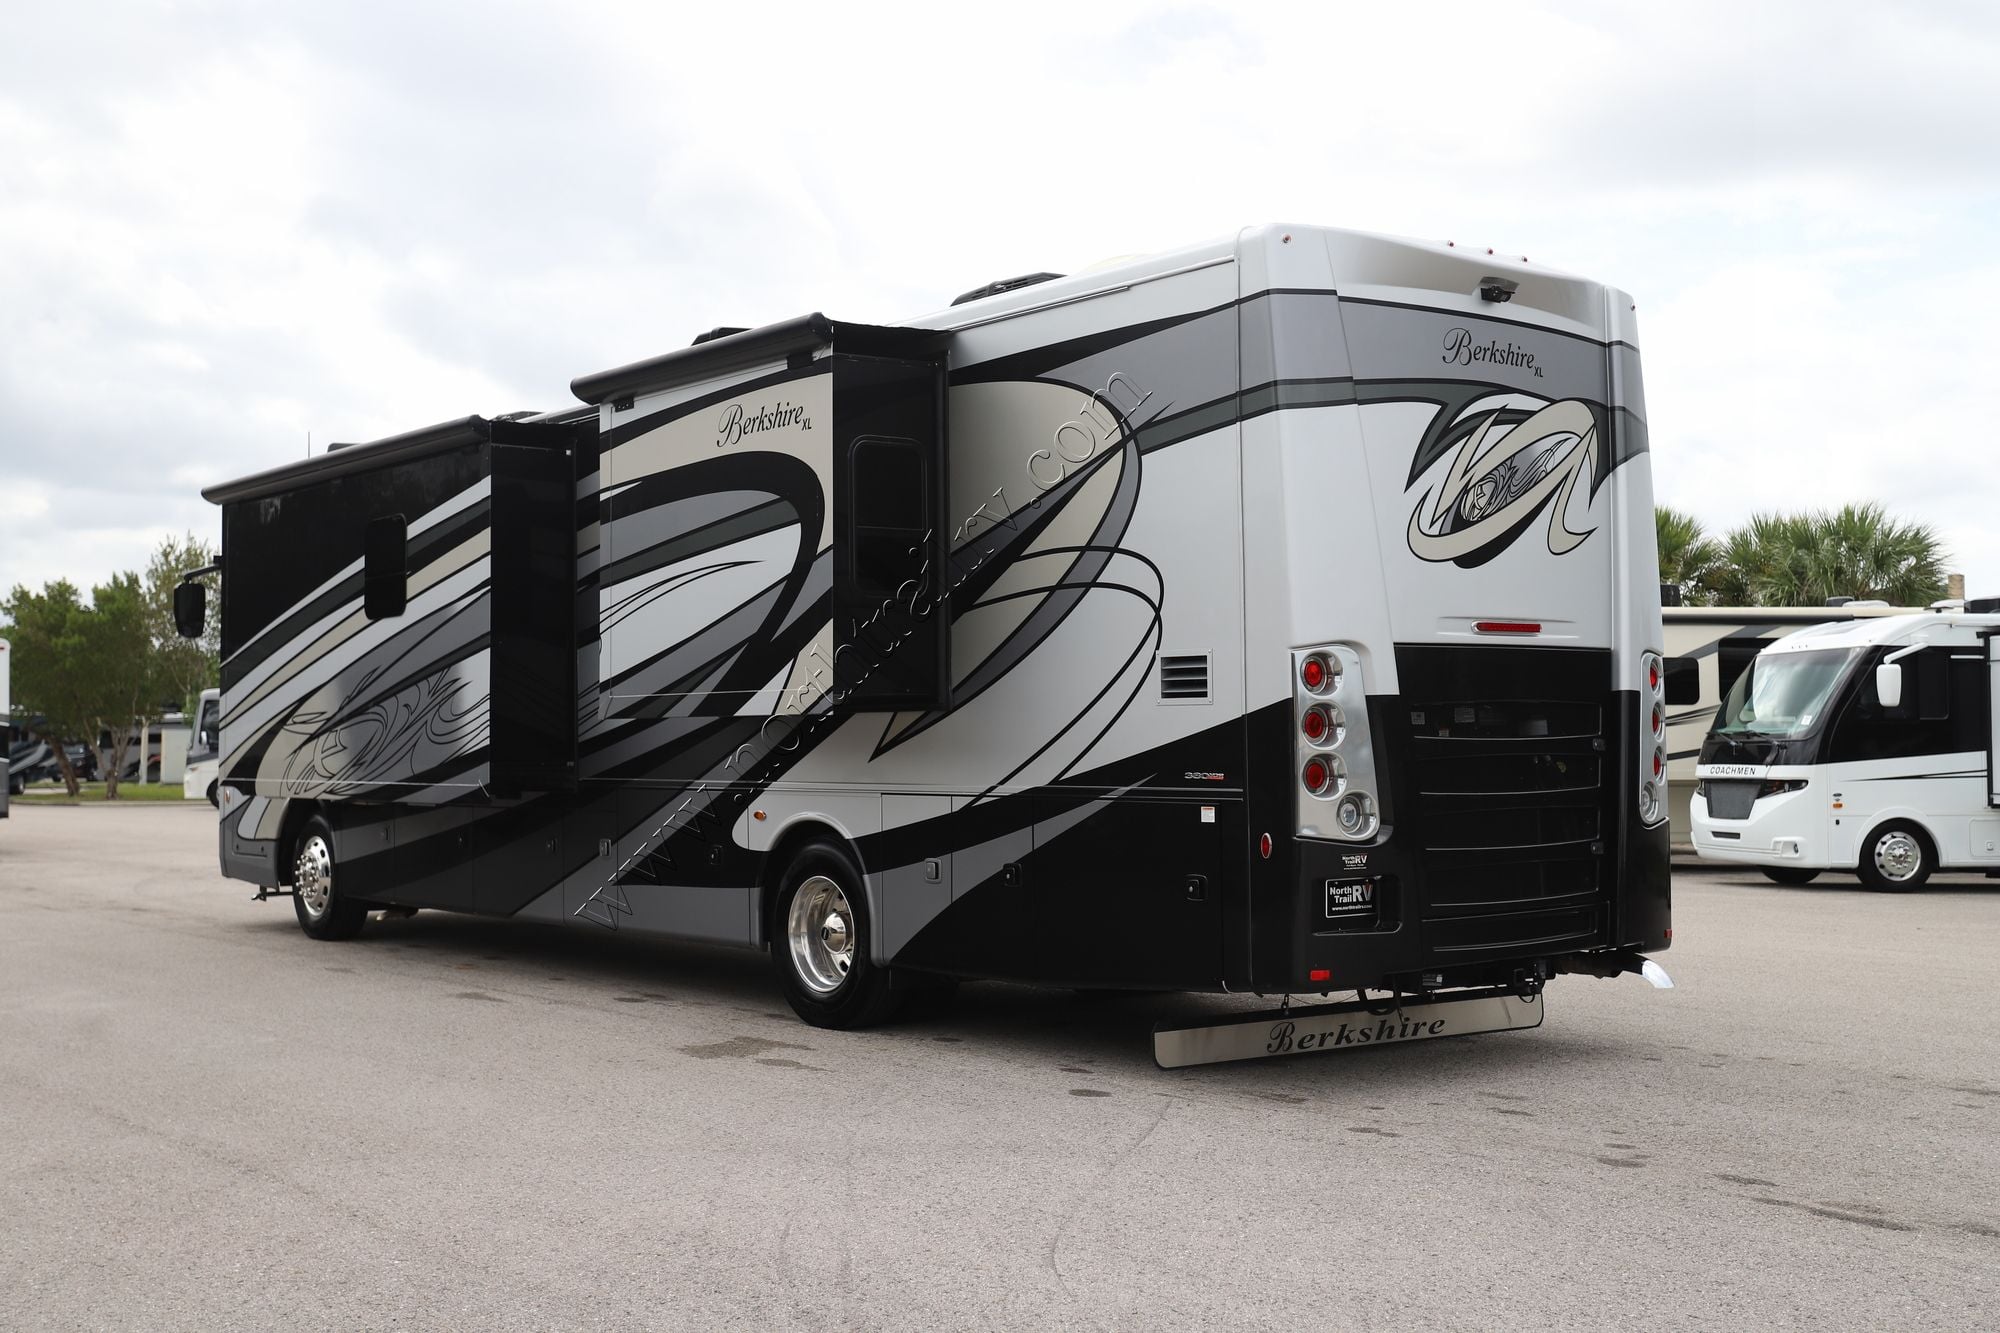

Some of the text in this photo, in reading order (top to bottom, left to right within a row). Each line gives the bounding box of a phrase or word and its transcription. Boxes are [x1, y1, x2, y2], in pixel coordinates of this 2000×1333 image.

[1442, 327, 1544, 378] Berkshire XL
[716, 400, 812, 448] Berkshire XL
[1710, 766, 1756, 775] COACHMEN
[1330, 886, 1352, 895] North
[1334, 895, 1352, 903] Trail
[1352, 885, 1373, 902] RV
[1266, 1017, 1446, 1053] Berkshire
